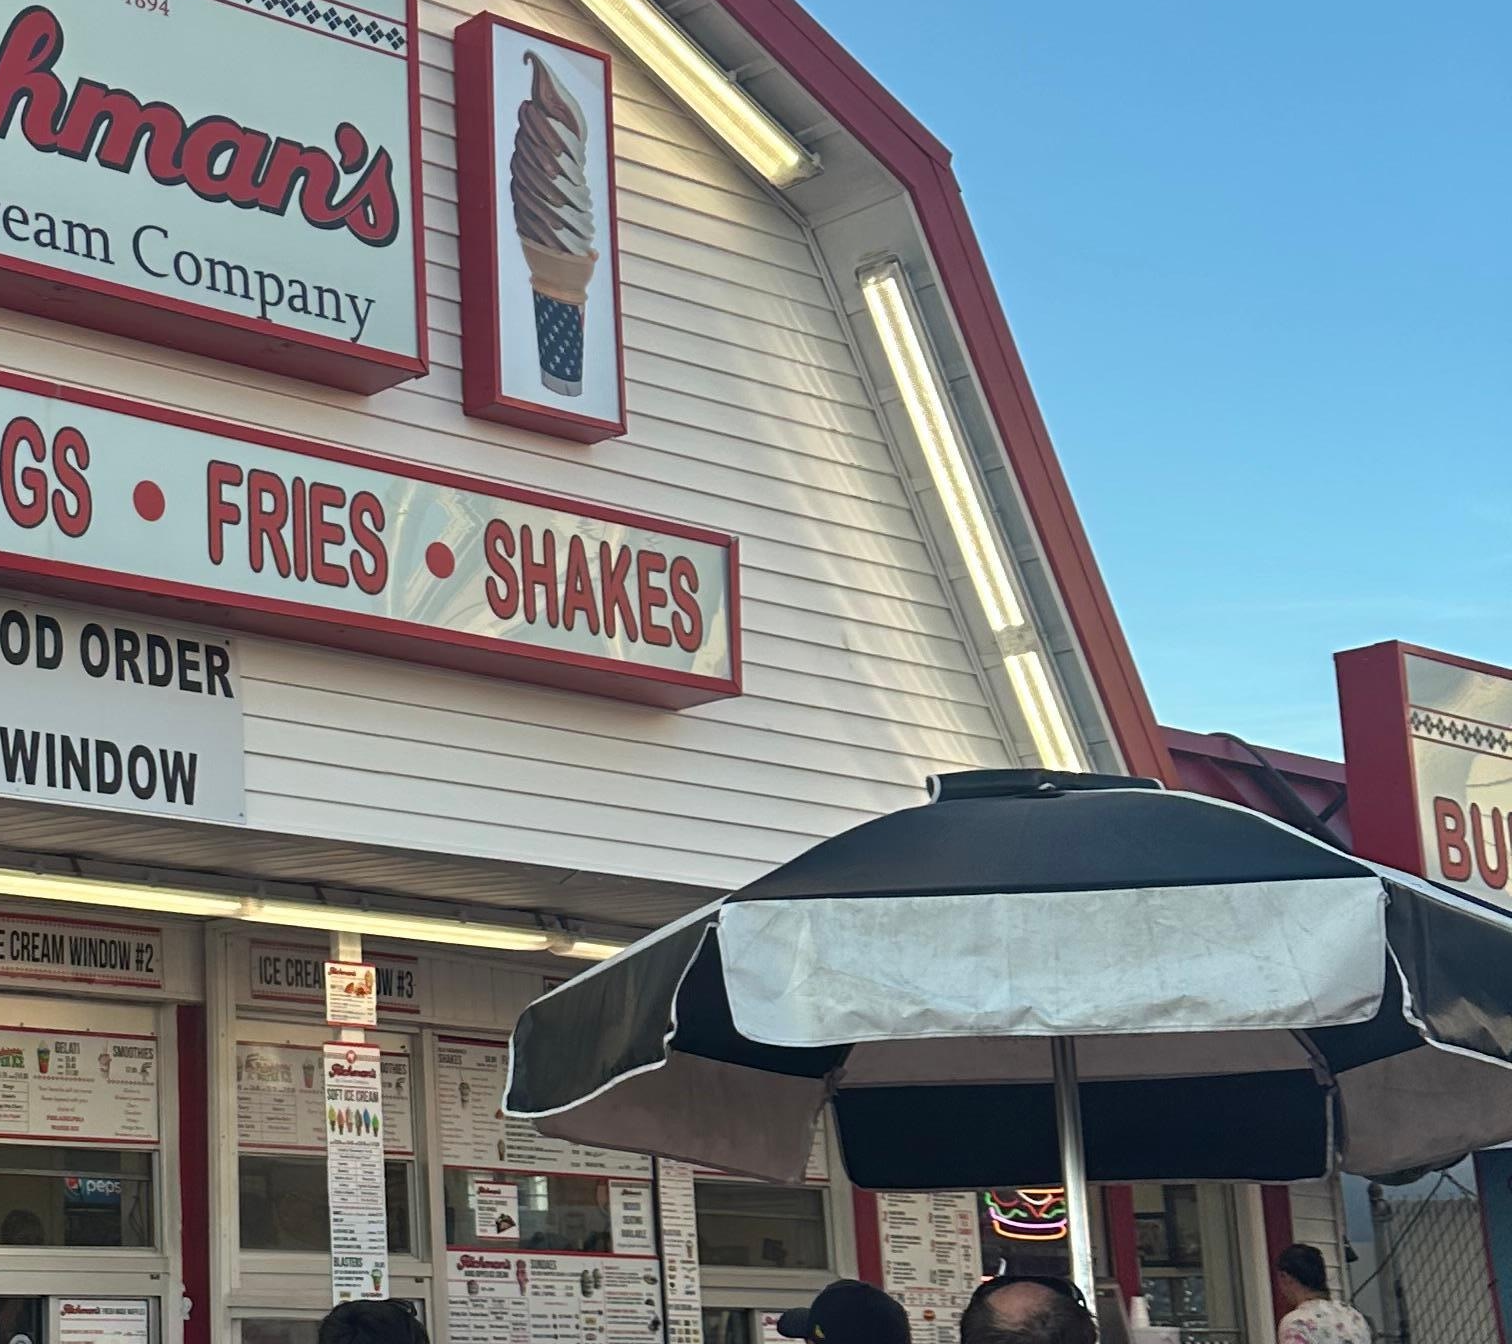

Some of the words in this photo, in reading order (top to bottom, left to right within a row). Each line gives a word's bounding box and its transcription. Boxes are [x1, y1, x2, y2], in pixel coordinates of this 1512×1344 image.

[132, 225, 376, 344] Company
[205, 458, 390, 596] FRIES
[484, 517, 704, 654] SHAKES
[79, 621, 235, 700] ORDER
[1433, 796, 1512, 890] BU
[10, 930, 65, 965] CREAM
[69, 936, 132, 971] WINDOW
[136, 942, 154, 973] #2
[259, 956, 281, 985] ICE
[285, 959, 325, 989] CREA
[396, 970, 414, 998] #3
[55, 1041, 81, 1054] GELATI
[113, 1045, 154, 1060] SMOOTHIES
[327, 1088, 342, 1100] SOFT
[344, 1089, 355, 1102] ICE
[356, 1090, 379, 1103] CREAM
[87, 1179, 122, 1195] peps
[334, 1257, 363, 1268] BLASTERS
